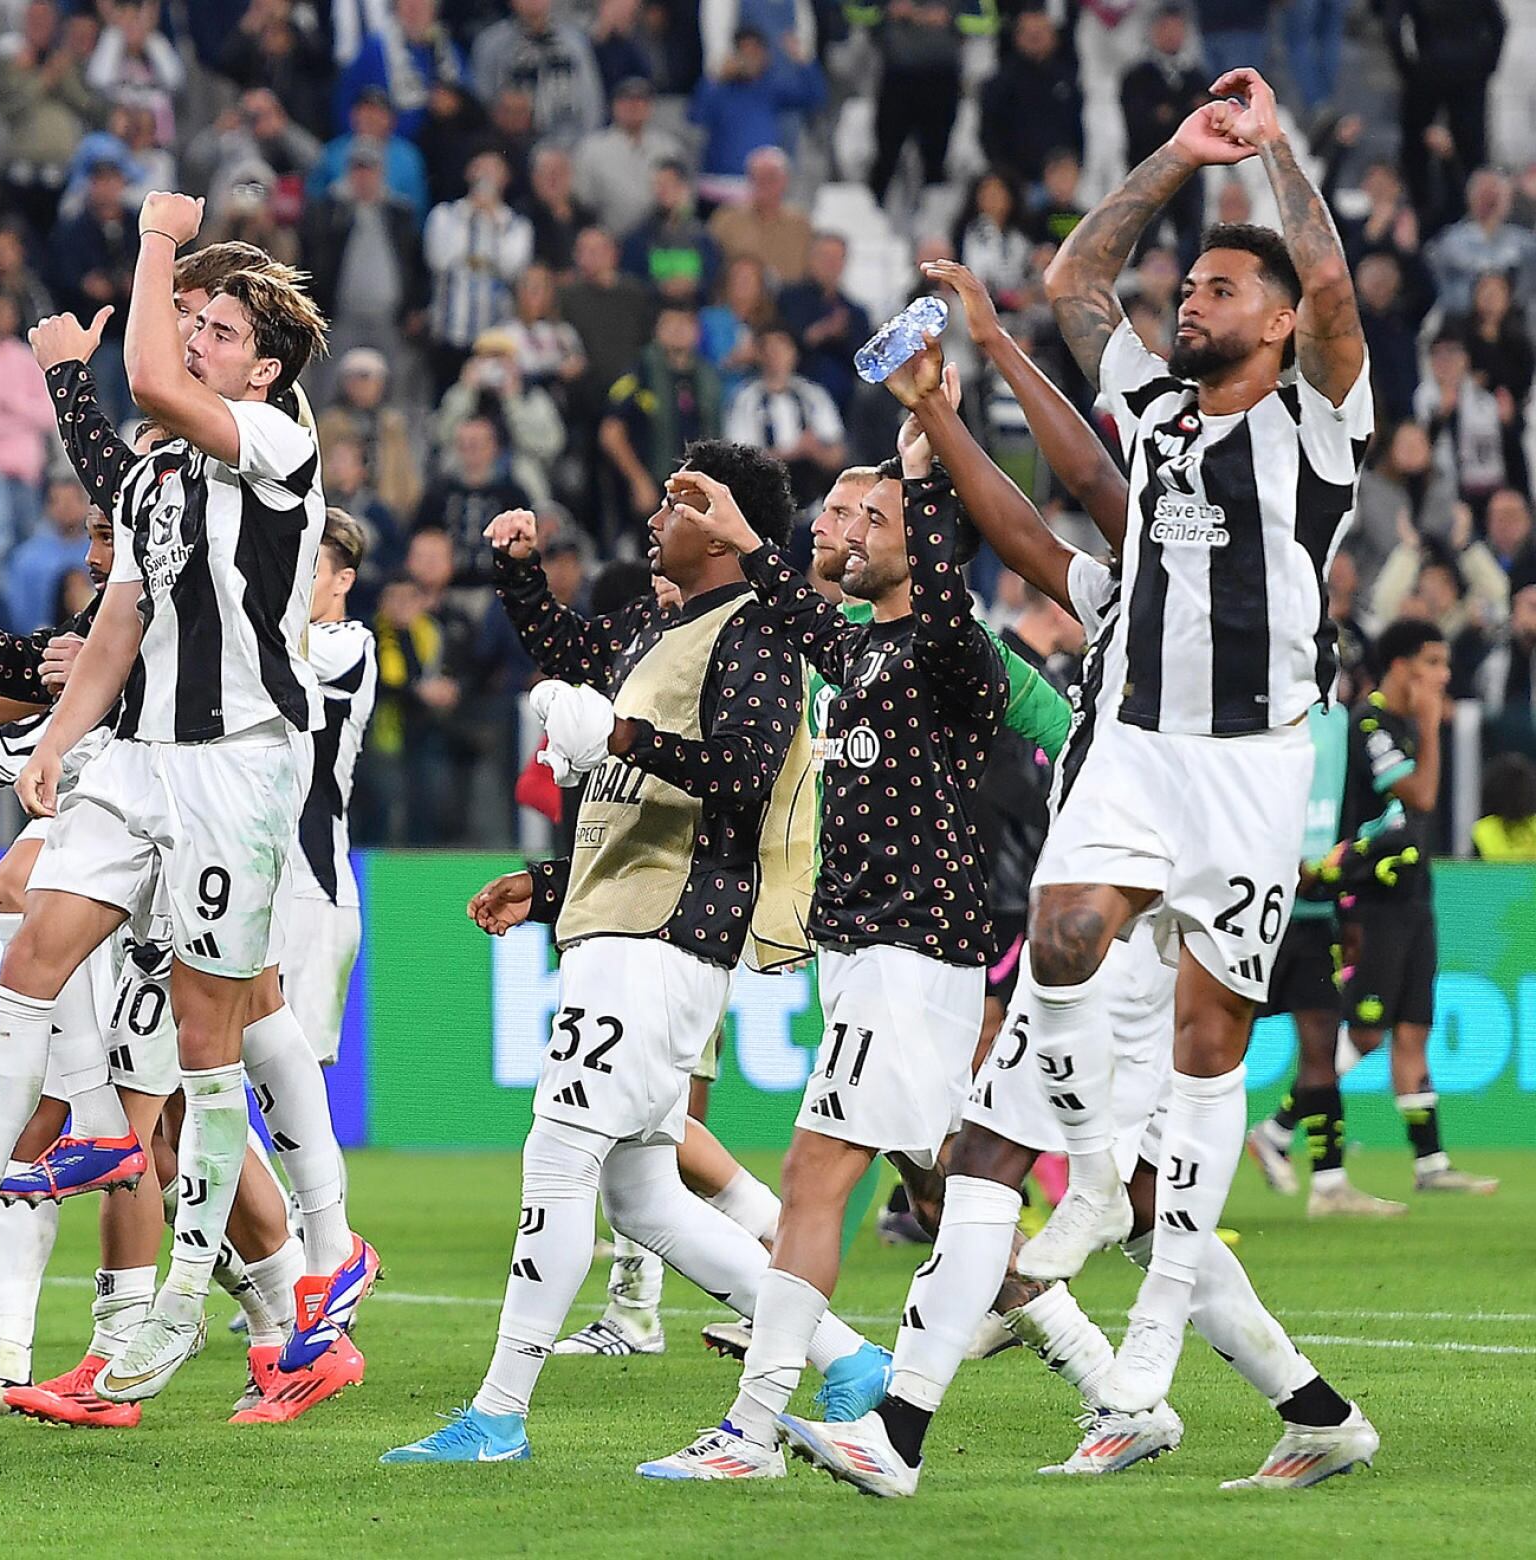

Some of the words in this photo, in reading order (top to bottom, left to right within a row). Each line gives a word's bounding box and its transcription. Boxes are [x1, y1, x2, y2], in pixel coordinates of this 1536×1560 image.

[1153, 522, 1227, 542] Children
[1157, 499, 1195, 518] Save
[1199, 505, 1223, 519] the
[145, 555, 168, 574] Save
[196, 866, 231, 920] 9
[1213, 876, 1283, 945] 26
[110, 976, 166, 1035] 10
[550, 1007, 624, 1074] 32
[825, 1022, 873, 1087] 11
